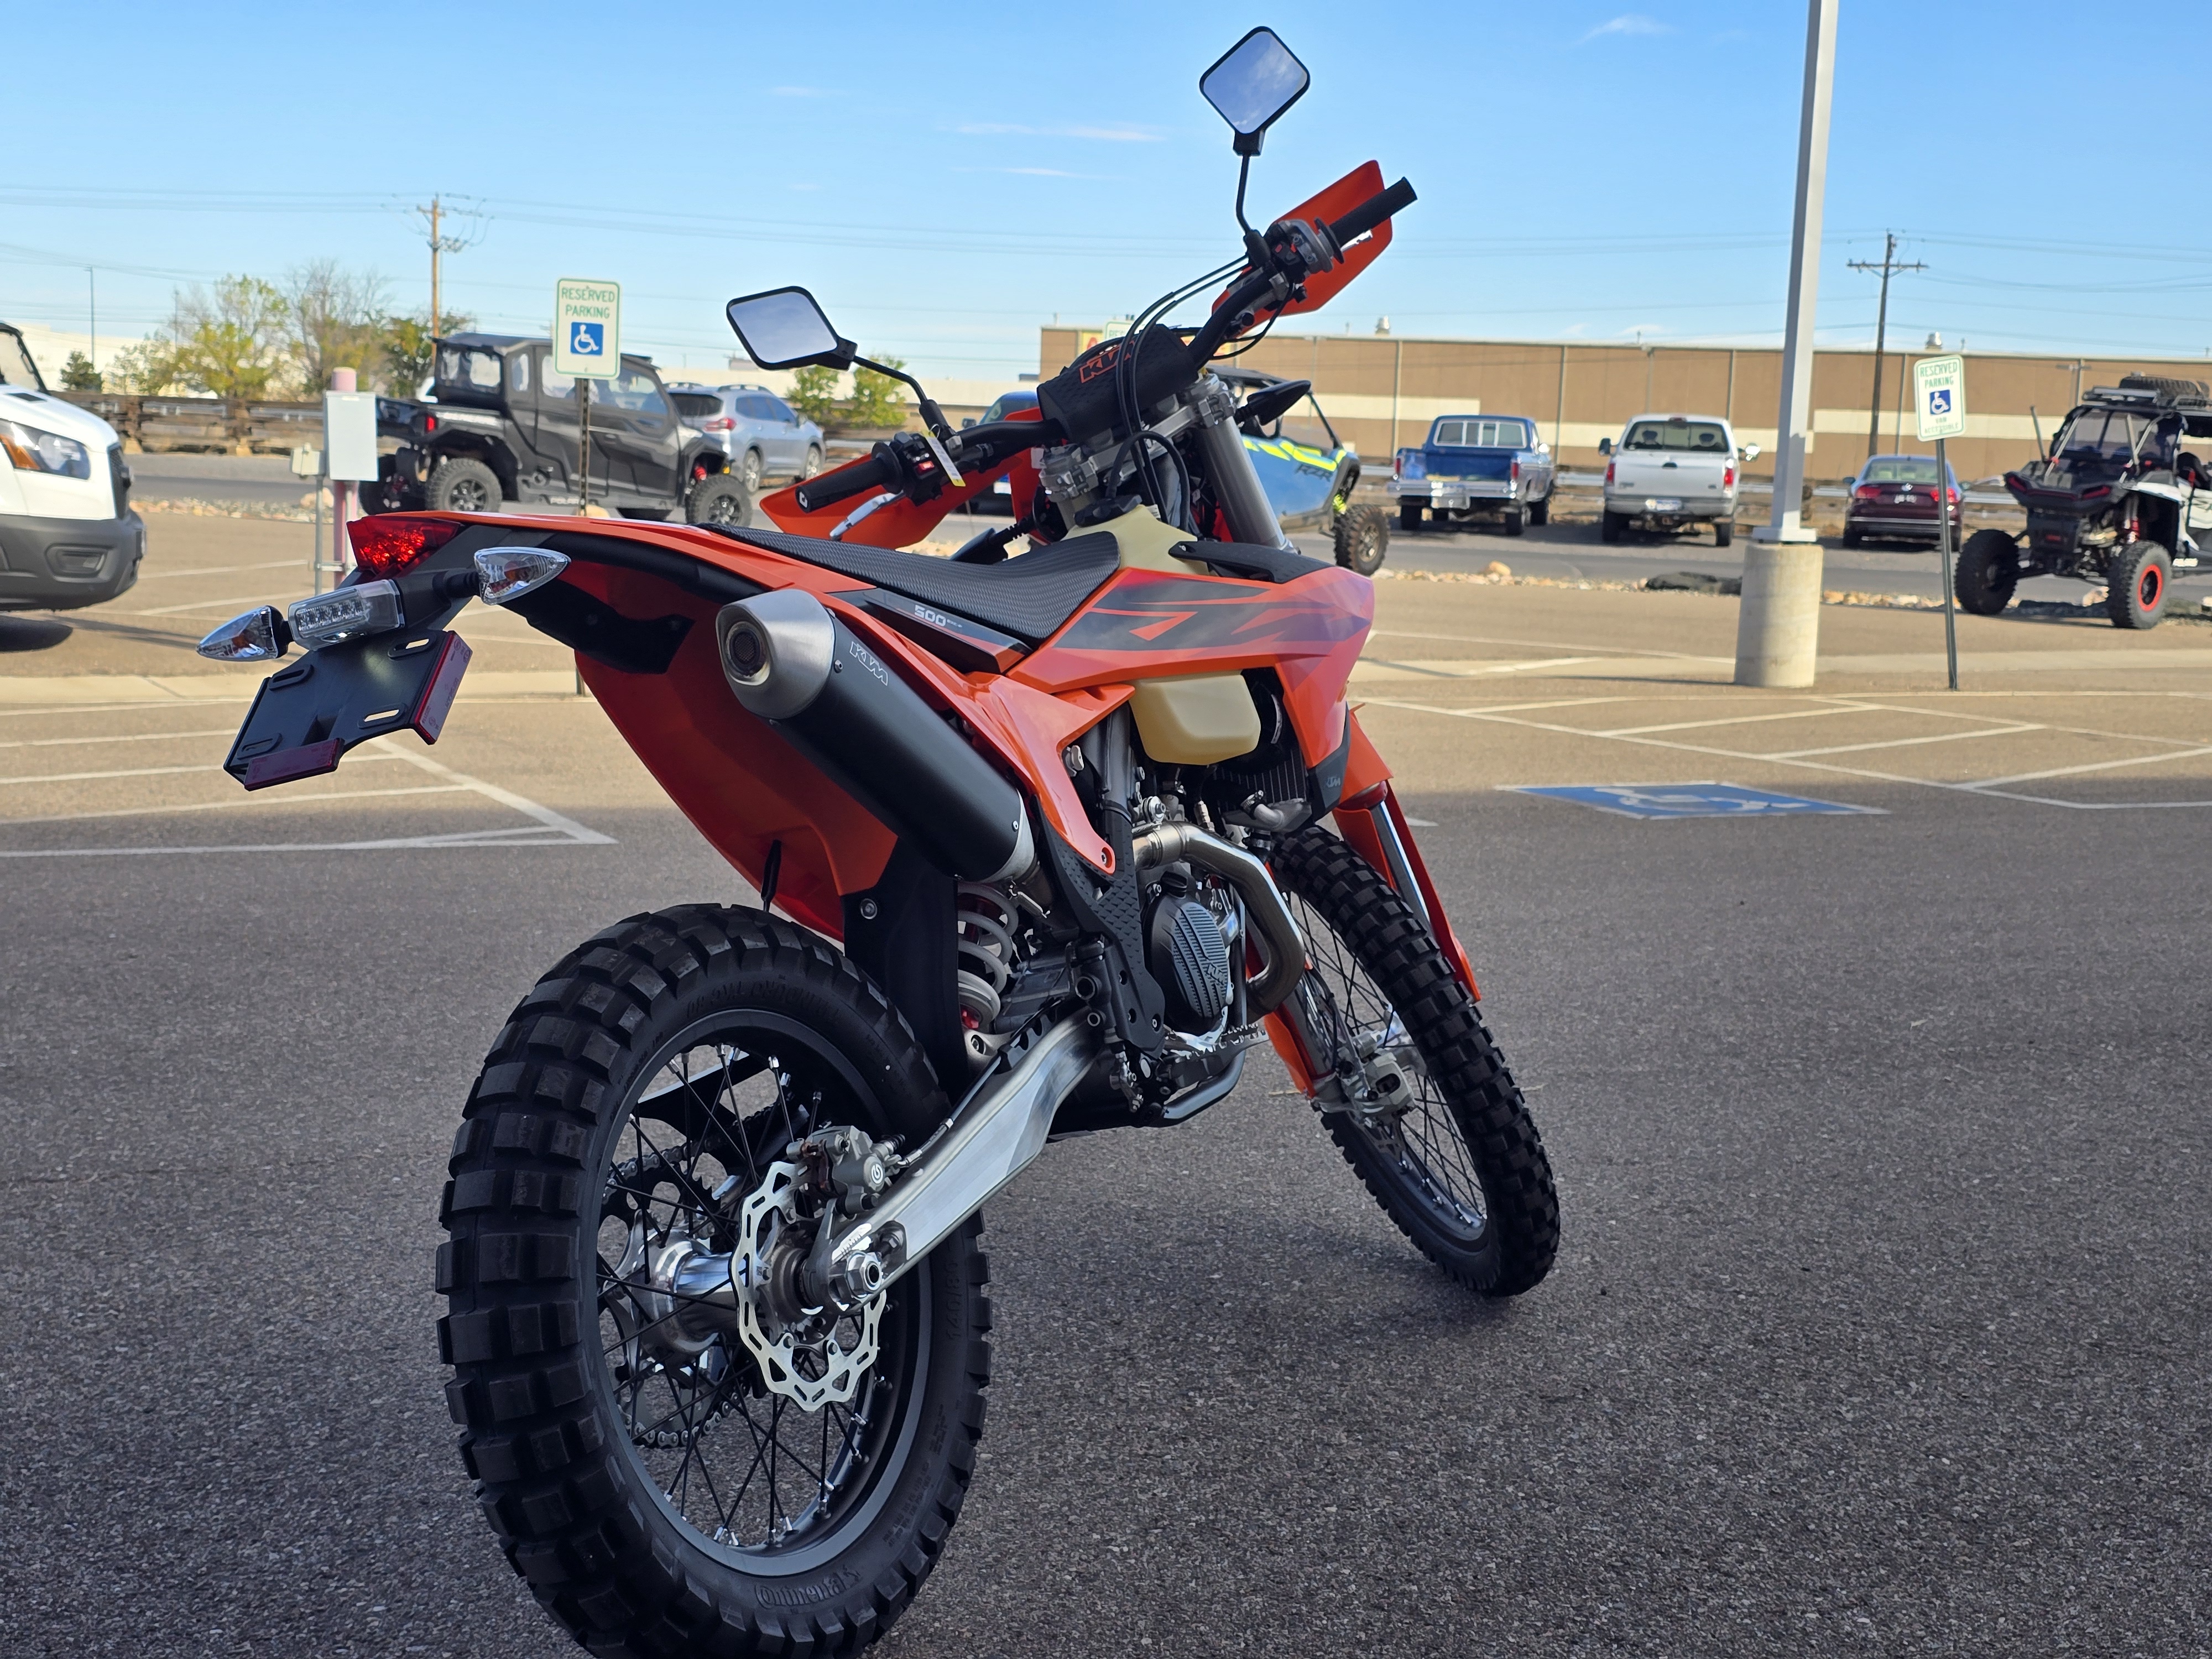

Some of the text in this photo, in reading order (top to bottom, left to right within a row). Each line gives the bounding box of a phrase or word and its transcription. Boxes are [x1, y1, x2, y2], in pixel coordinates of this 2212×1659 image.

[561, 287, 615, 303] RESERVED
[565, 304, 610, 319] PARKING
[1919, 362, 1958, 378] RESERVED
[1924, 375, 1954, 389] PARKING
[914, 604, 946, 627] 500
[849, 641, 888, 686] KTM
[754, 1571, 848, 1610] Continental
